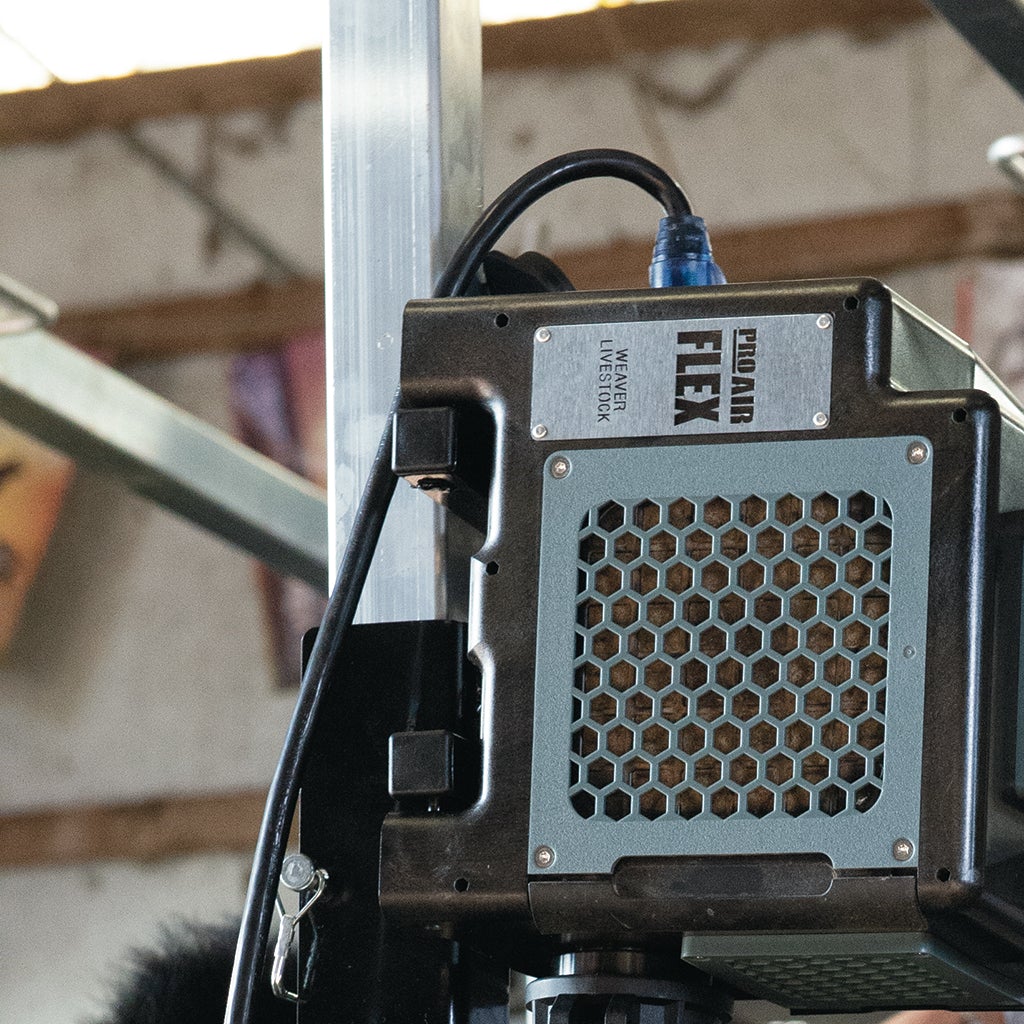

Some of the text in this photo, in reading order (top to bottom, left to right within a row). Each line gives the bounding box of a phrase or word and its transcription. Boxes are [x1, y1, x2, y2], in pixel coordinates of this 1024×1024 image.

[597, 339, 613, 422] LIVESTOCK
[613, 348, 628, 411] WEAVER
[674, 329, 722, 426] FLEX
